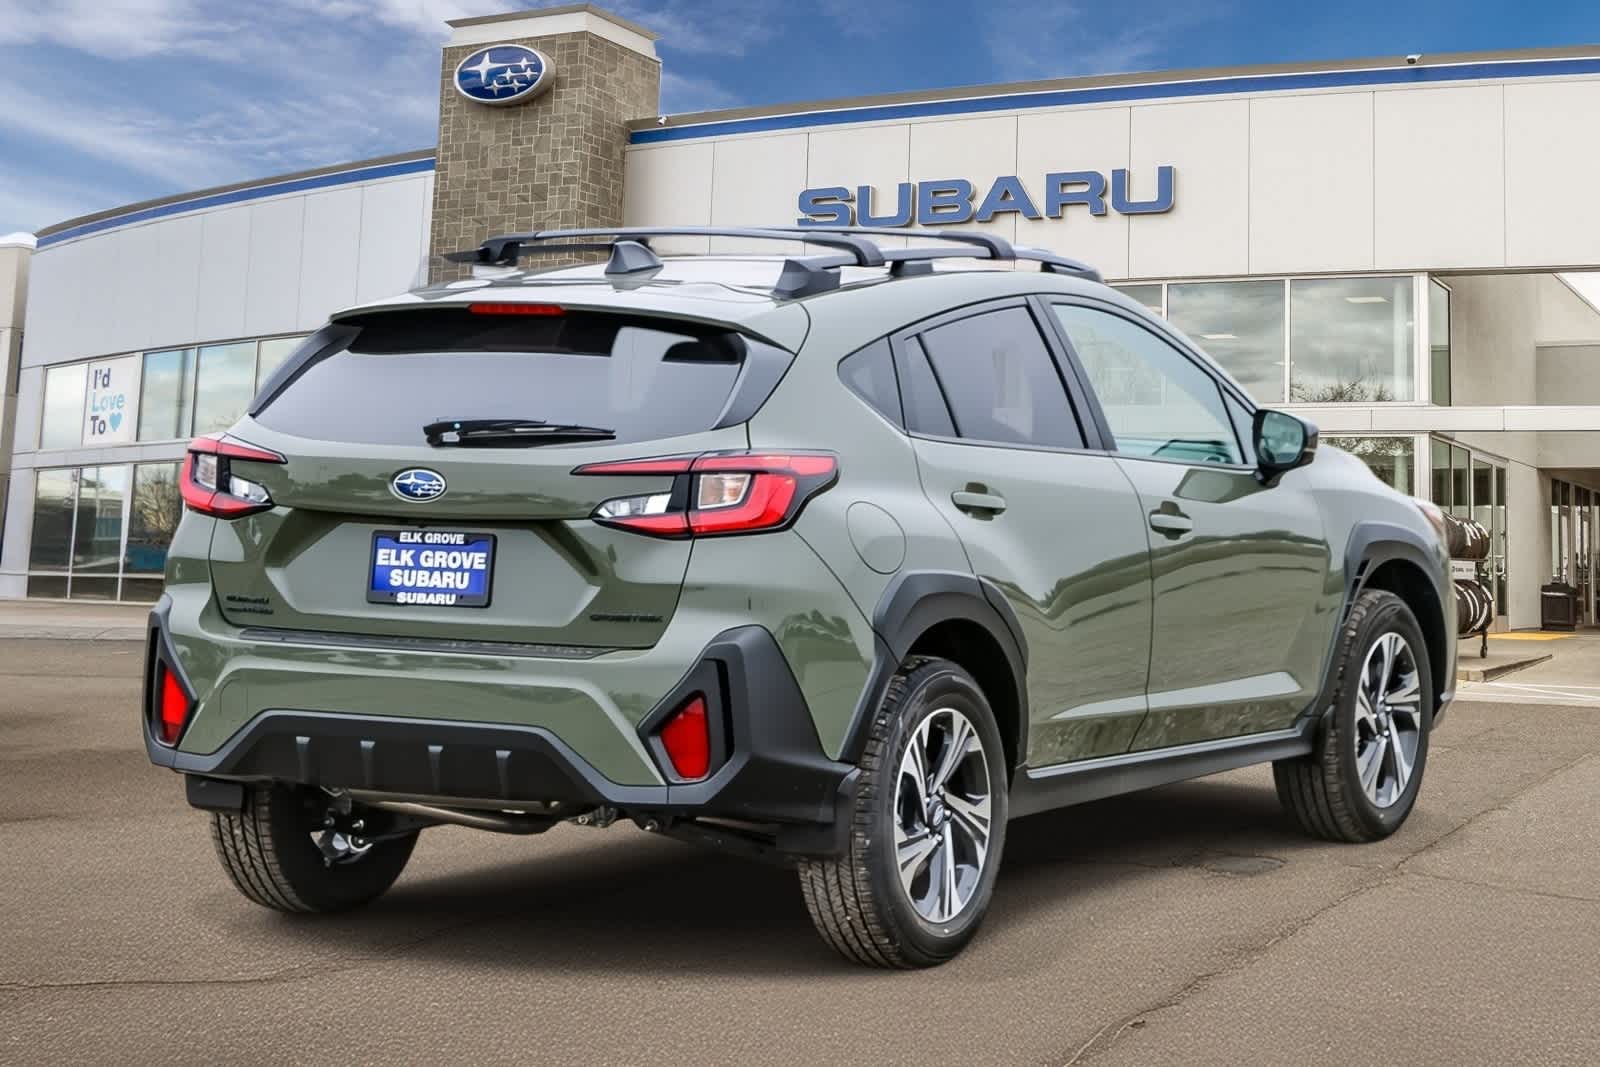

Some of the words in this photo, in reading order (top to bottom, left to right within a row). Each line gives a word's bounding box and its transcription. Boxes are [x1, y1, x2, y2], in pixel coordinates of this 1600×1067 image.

[797, 166, 1176, 228] SUBARU
[91, 392, 125, 413] Love
[90, 415, 106, 435] To
[399, 532, 422, 543] ELK
[424, 533, 465, 545] GROVE
[376, 548, 416, 567] ELK
[419, 550, 487, 570] GROVE
[389, 569, 470, 589] SUBARU
[396, 591, 456, 605] SUBARU
